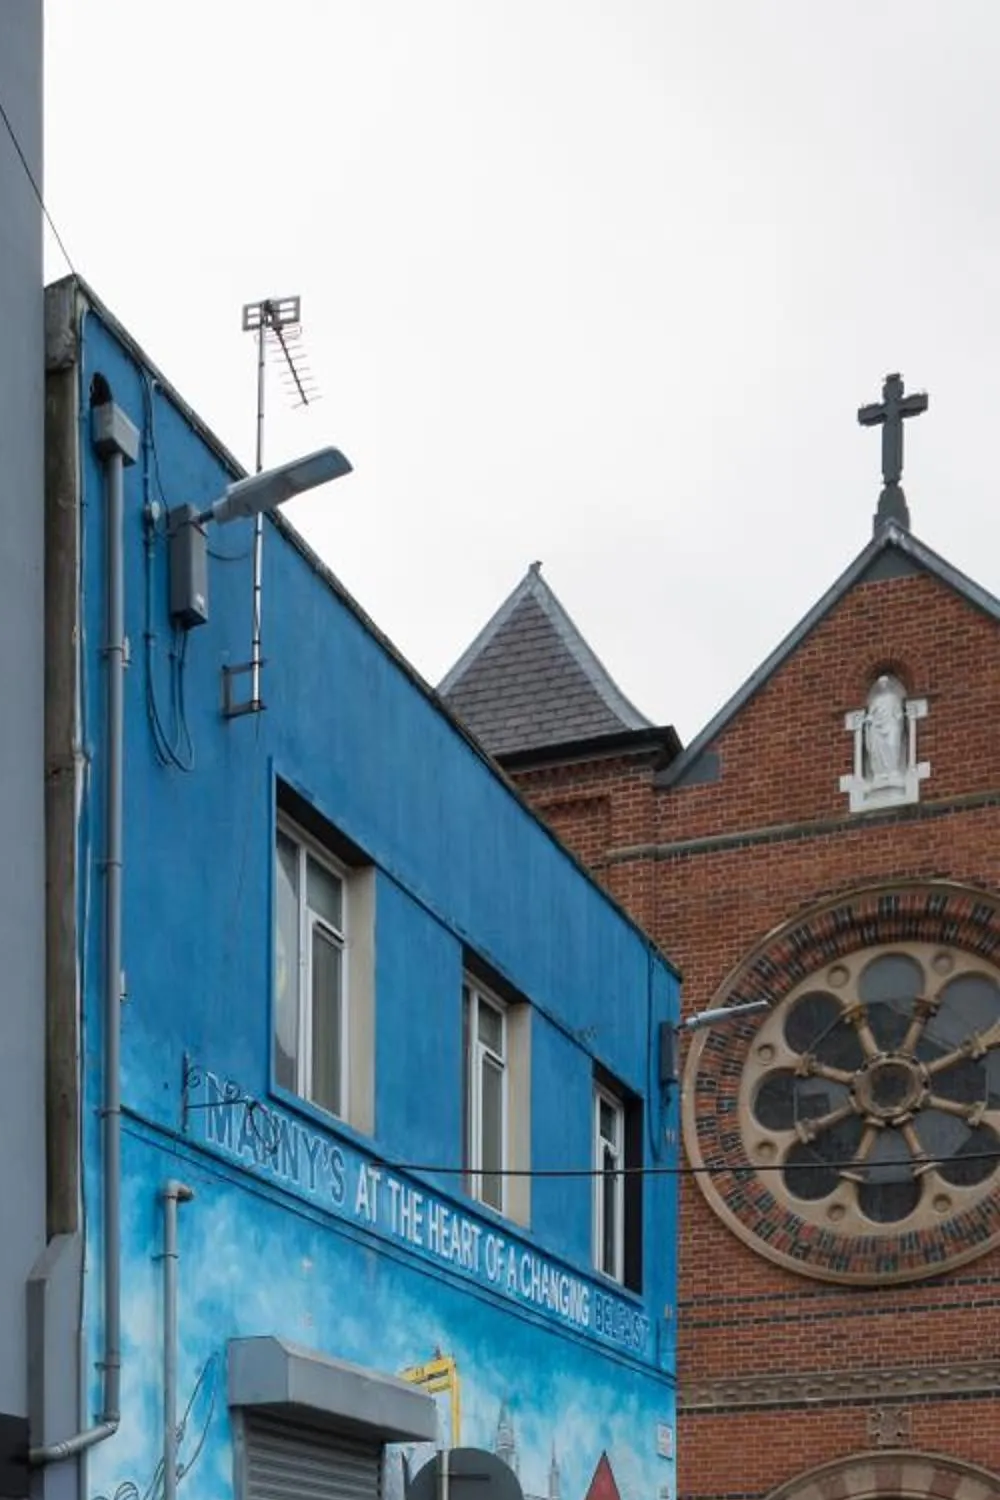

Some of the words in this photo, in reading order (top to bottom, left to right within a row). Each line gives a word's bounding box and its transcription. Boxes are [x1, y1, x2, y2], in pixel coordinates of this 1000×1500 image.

[205, 1071, 345, 1207] MANNY'S
[355, 1161, 381, 1224] AT
[387, 1178, 424, 1245] THE
[428, 1200, 483, 1272] HEART
[485, 1234, 505, 1284] OF
[507, 1245, 518, 1294] A
[520, 1254, 590, 1326] CHANGING
